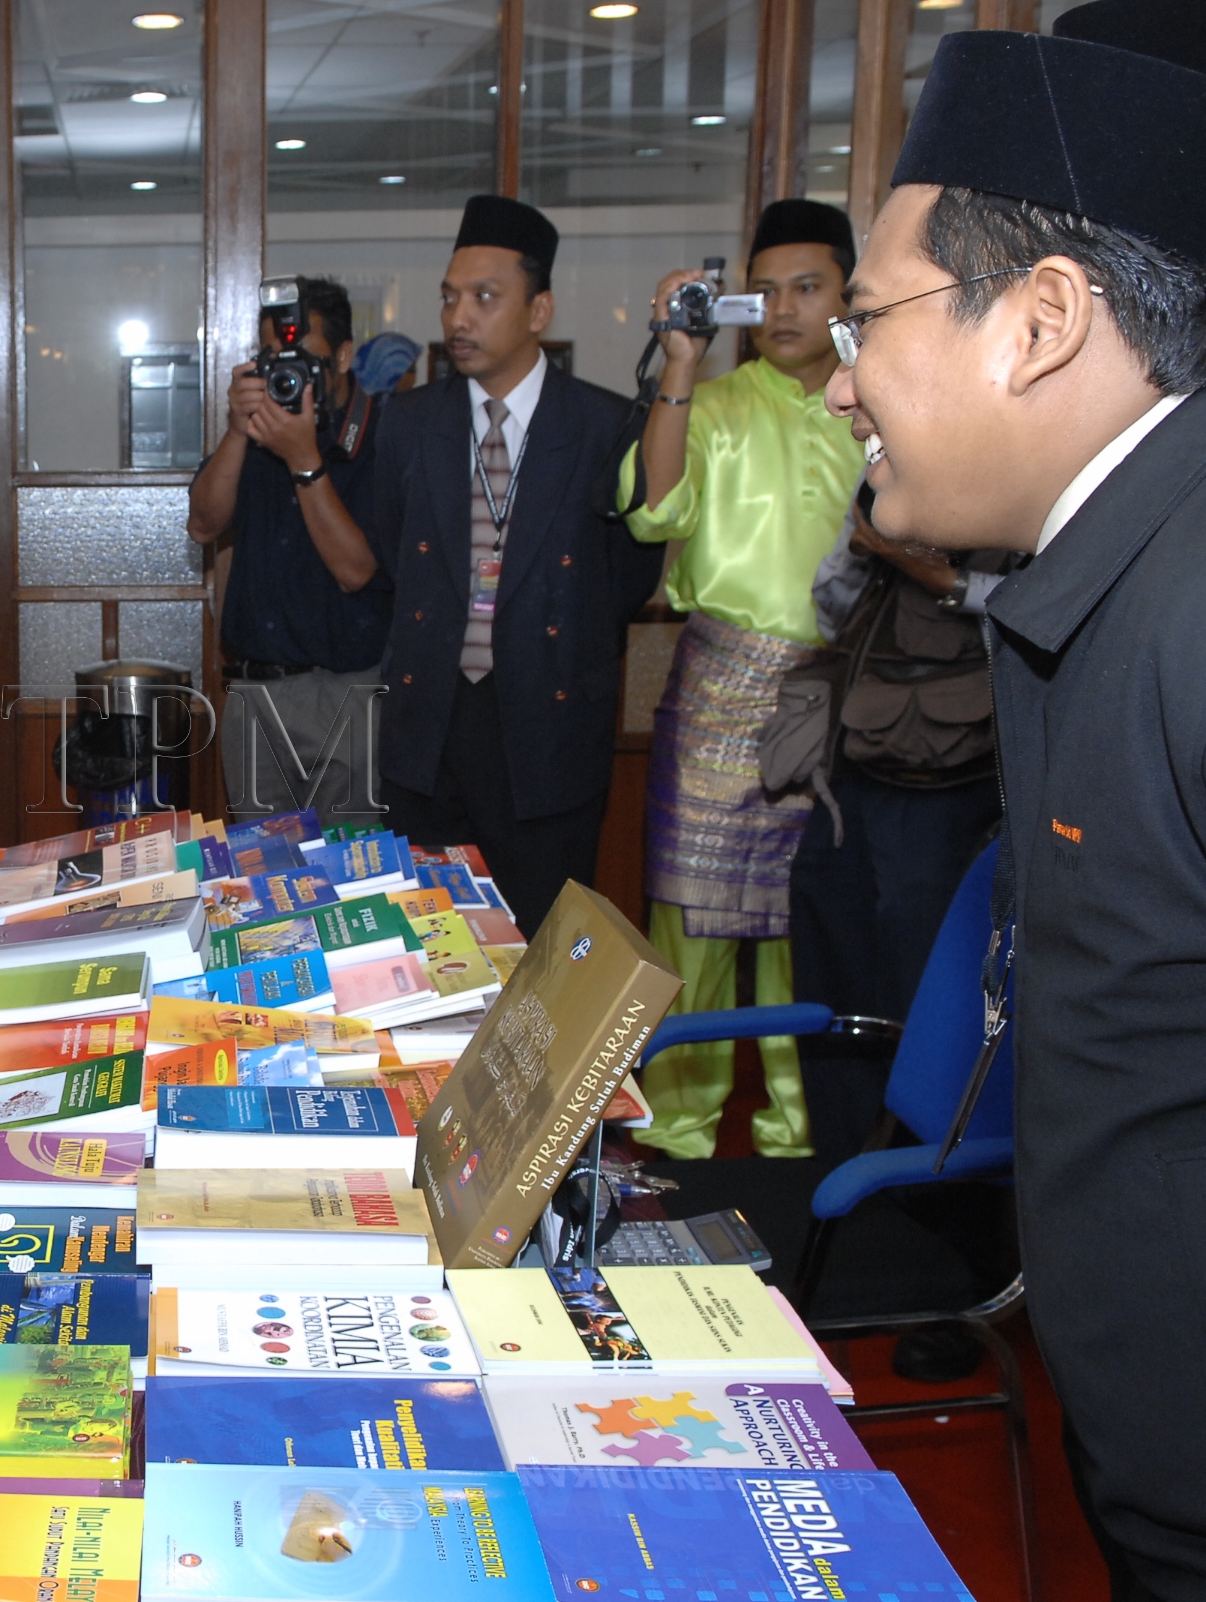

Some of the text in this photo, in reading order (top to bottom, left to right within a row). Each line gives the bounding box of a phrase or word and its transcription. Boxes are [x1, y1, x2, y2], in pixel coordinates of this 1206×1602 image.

[359, 908, 378, 932] FIZIK
[296, 1090, 327, 1128] Pendidikan
[516, 1117, 573, 1198] ASPIRASI
[568, 999, 647, 1115] KEBITARAAN
[540, 1170, 560, 1191] Ibu
[557, 1115, 596, 1168] Kandung
[590, 1078, 617, 1114] Suluh
[613, 1025, 651, 1076] Budiman
[84, 1143, 103, 1173] Hala Tuju
[344, 1171, 399, 1227] TEORI BAHASA
[60, 1236, 85, 1272] Kaunseling
[88, 1225, 110, 1262] Mendengar
[114, 1215, 135, 1252] Kemahiran
[0, 1304, 15, 1313] di
[58, 1305, 75, 1346] Alam Sekita
[75, 1279, 94, 1340] Pembangunan dan
[300, 1296, 330, 1369] KOORDINATAN
[324, 1297, 384, 1369] KIMIA
[374, 1296, 412, 1371] PENGENALAN
[744, 1384, 765, 1396] A
[375, 1420, 406, 1470] Kualitati
[730, 1398, 779, 1467] APPROACH
[776, 1398, 826, 1471] Classroom & Life
[792, 1398, 839, 1469] Creativity in the
[234, 1526, 244, 1548] HUSSIN
[423, 1487, 448, 1562] MALAYSIA Experiences
[455, 1513, 468, 1535] Theory
[461, 1537, 470, 1545] To
[463, 1488, 507, 1578] LEARNING TO BE REFLECTIVE
[628, 1513, 642, 1537] KASSIM
[636, 1537, 647, 1549] BIN
[745, 1479, 828, 1601] PENDIDIKAN
[773, 1480, 850, 1600] MEDIA dalam
[36, 1506, 70, 1602] SATU SUDUT PANDANGAN ORAN
[67, 1507, 110, 1602] NILAI-NILAI MELAY
[464, 1547, 478, 1583] Practices
